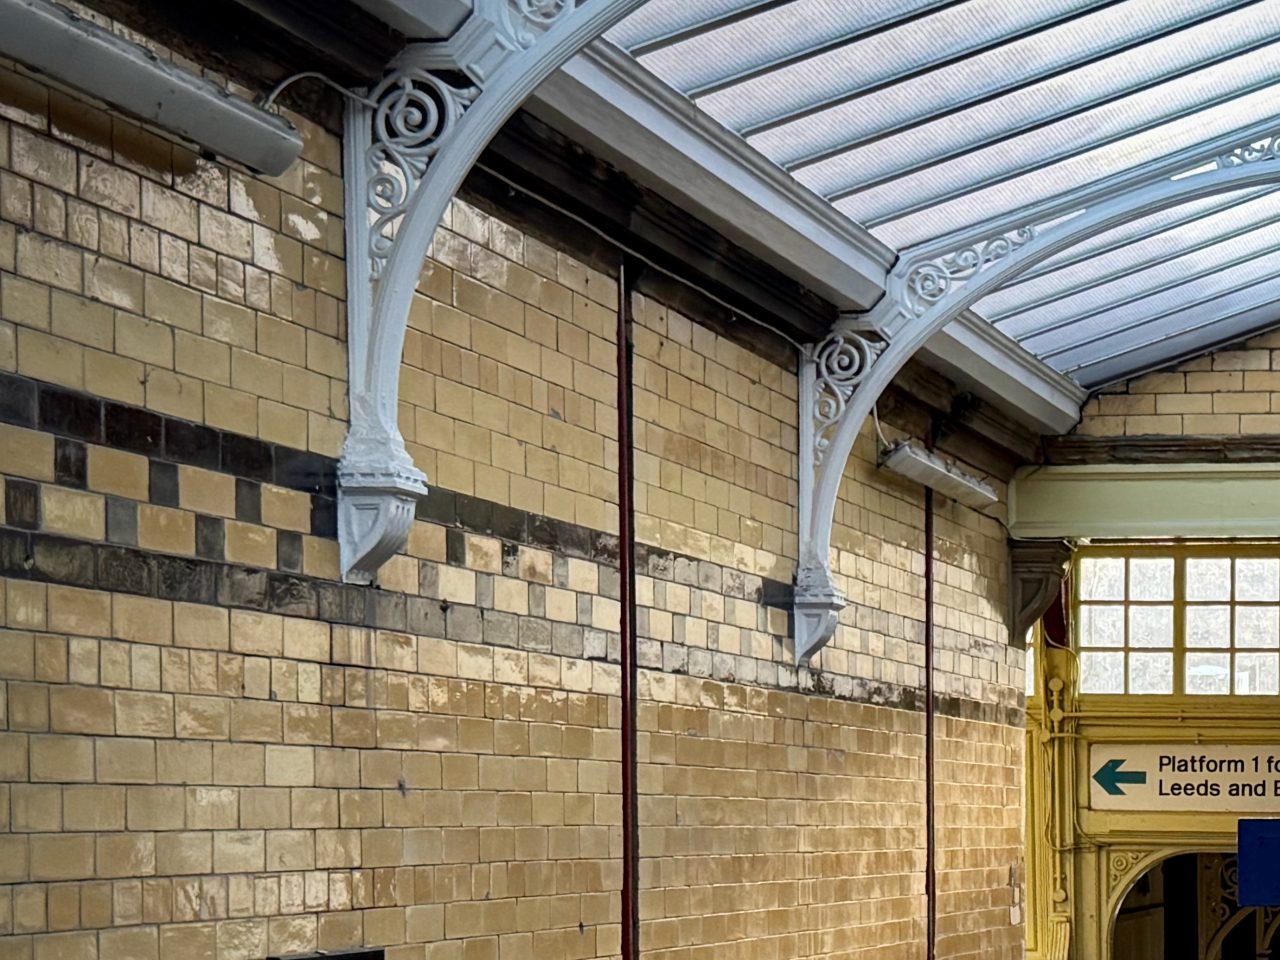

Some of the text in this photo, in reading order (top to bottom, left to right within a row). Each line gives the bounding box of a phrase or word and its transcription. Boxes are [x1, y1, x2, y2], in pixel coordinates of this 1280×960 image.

[1159, 755, 1245, 773] Platform
[1252, 756, 1259, 773] 1
[1158, 779, 1221, 797] Leeds
[1228, 780, 1266, 797] and
